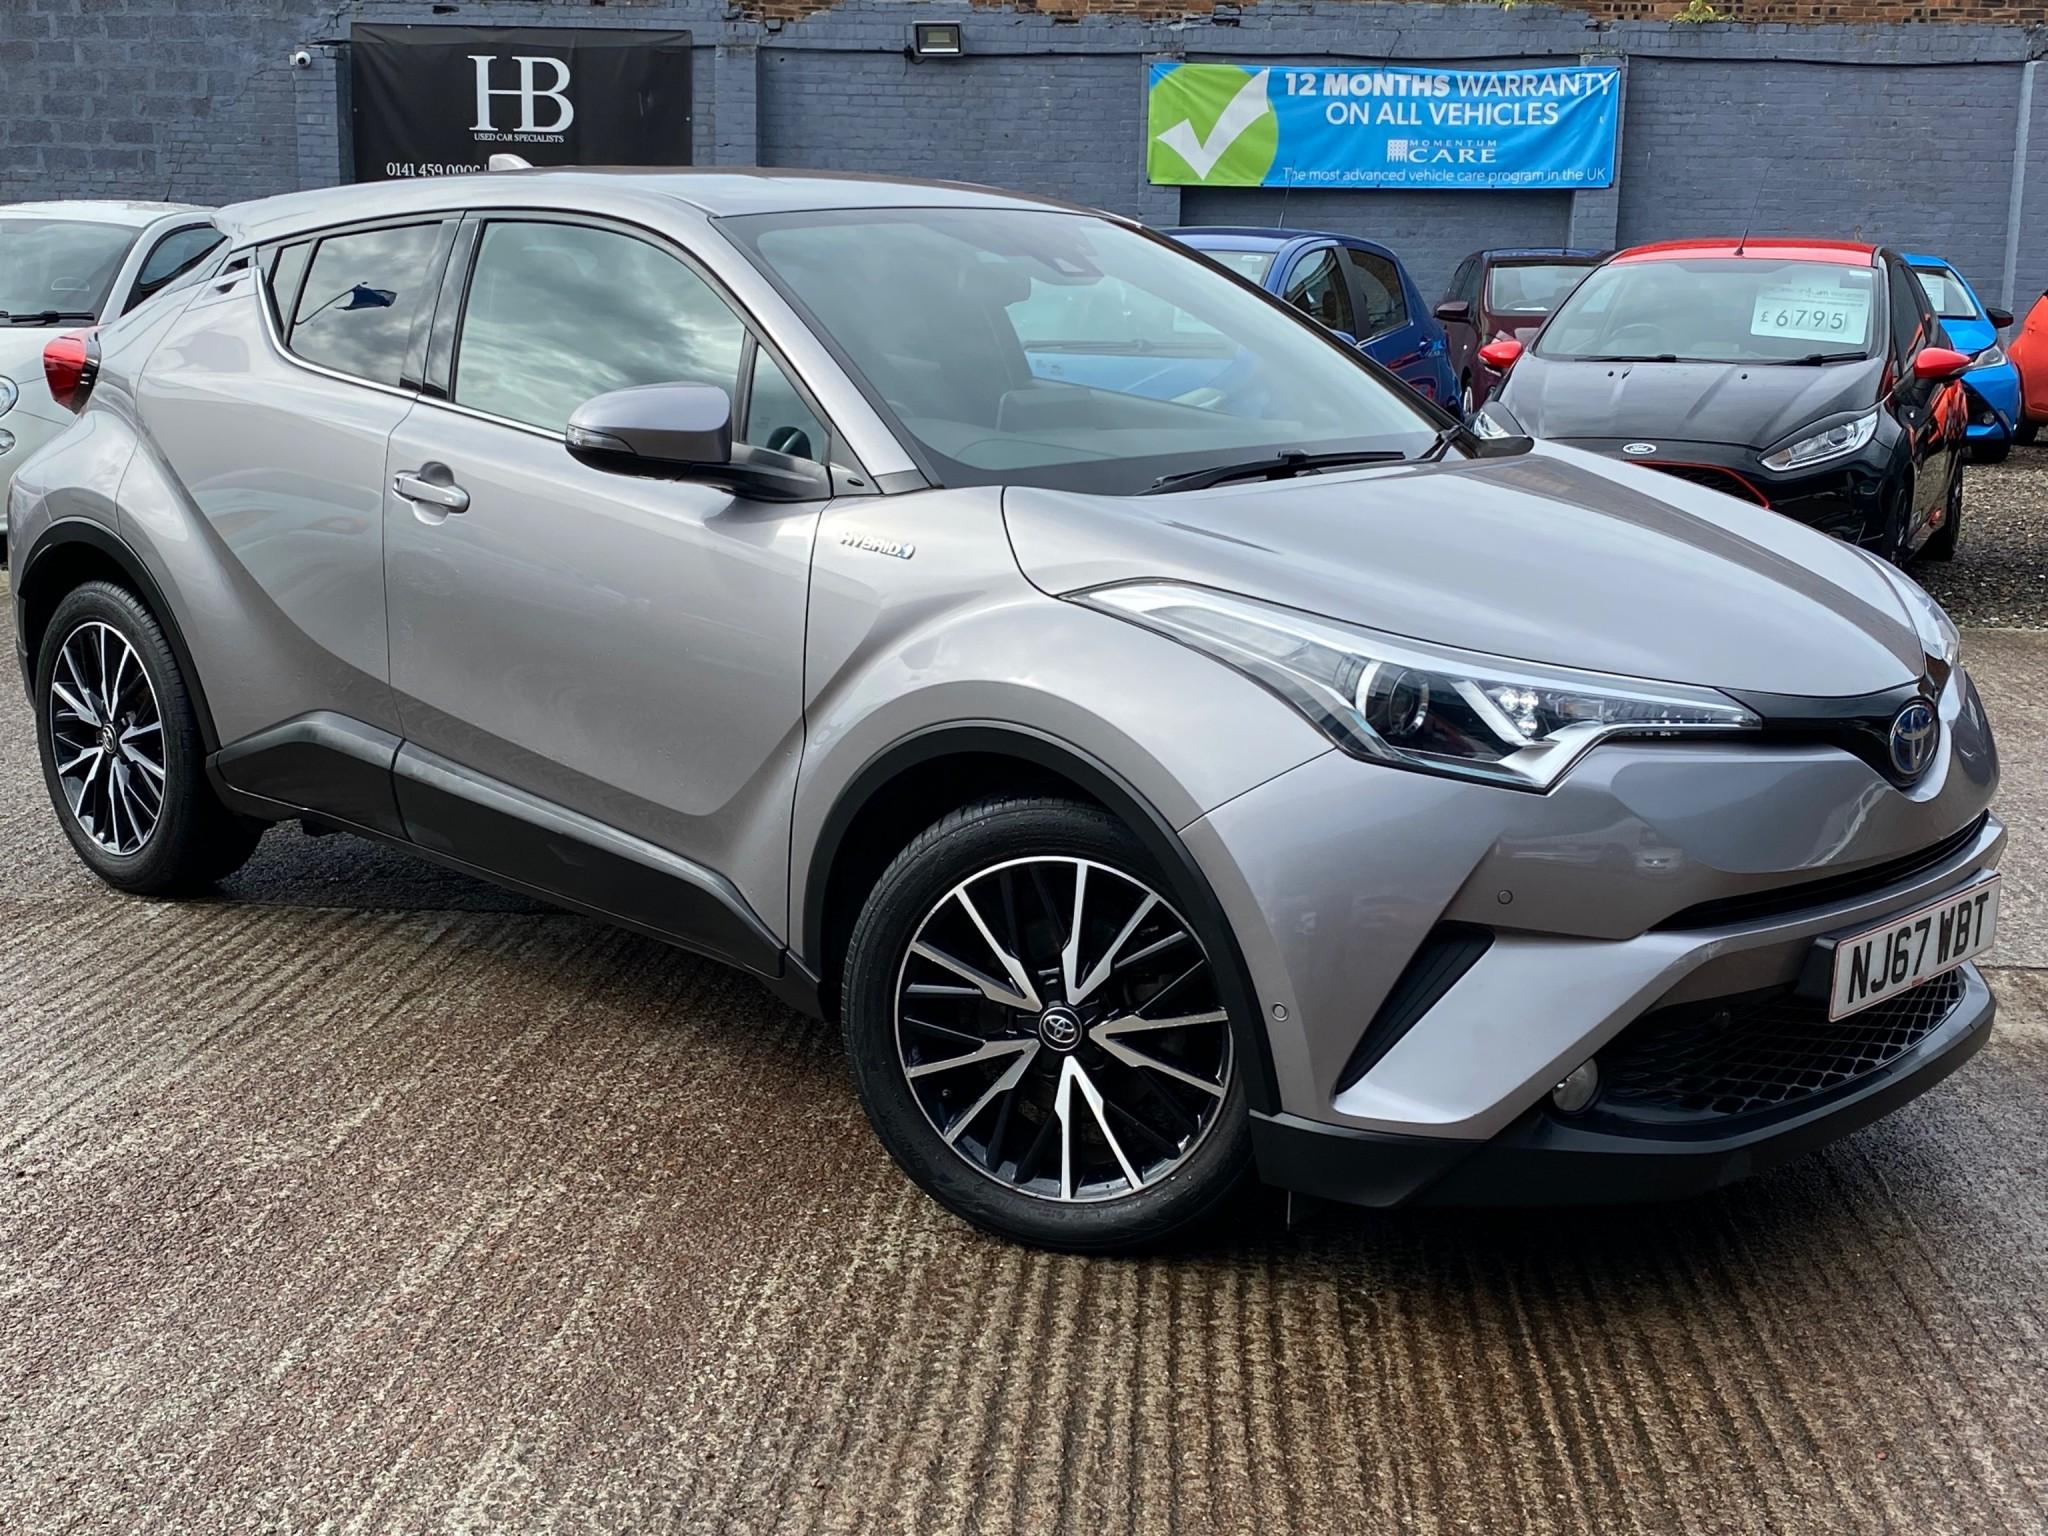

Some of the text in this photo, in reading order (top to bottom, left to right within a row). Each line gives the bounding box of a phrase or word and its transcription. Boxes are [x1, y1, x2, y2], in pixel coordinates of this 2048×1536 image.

[467, 55, 574, 132] HB
[1285, 73, 1613, 97] 12 MONTHS WARRANTY
[1326, 102, 1559, 126] ON ALL VEHICLES
[474, 133, 565, 143] USED CAR SPECIALISTS
[1409, 139, 1497, 147] MOMENTUM
[1408, 148, 1497, 163] CARE
[386, 162, 416, 177] 0141
[418, 163, 443, 177] 459
[1282, 167, 1606, 184] The most advanced vehicle care program in the UK
[1776, 309, 1843, 329] 6795
[840, 532, 904, 558] HYBRID
[1848, 892, 1989, 1004] NJ67 WBT
